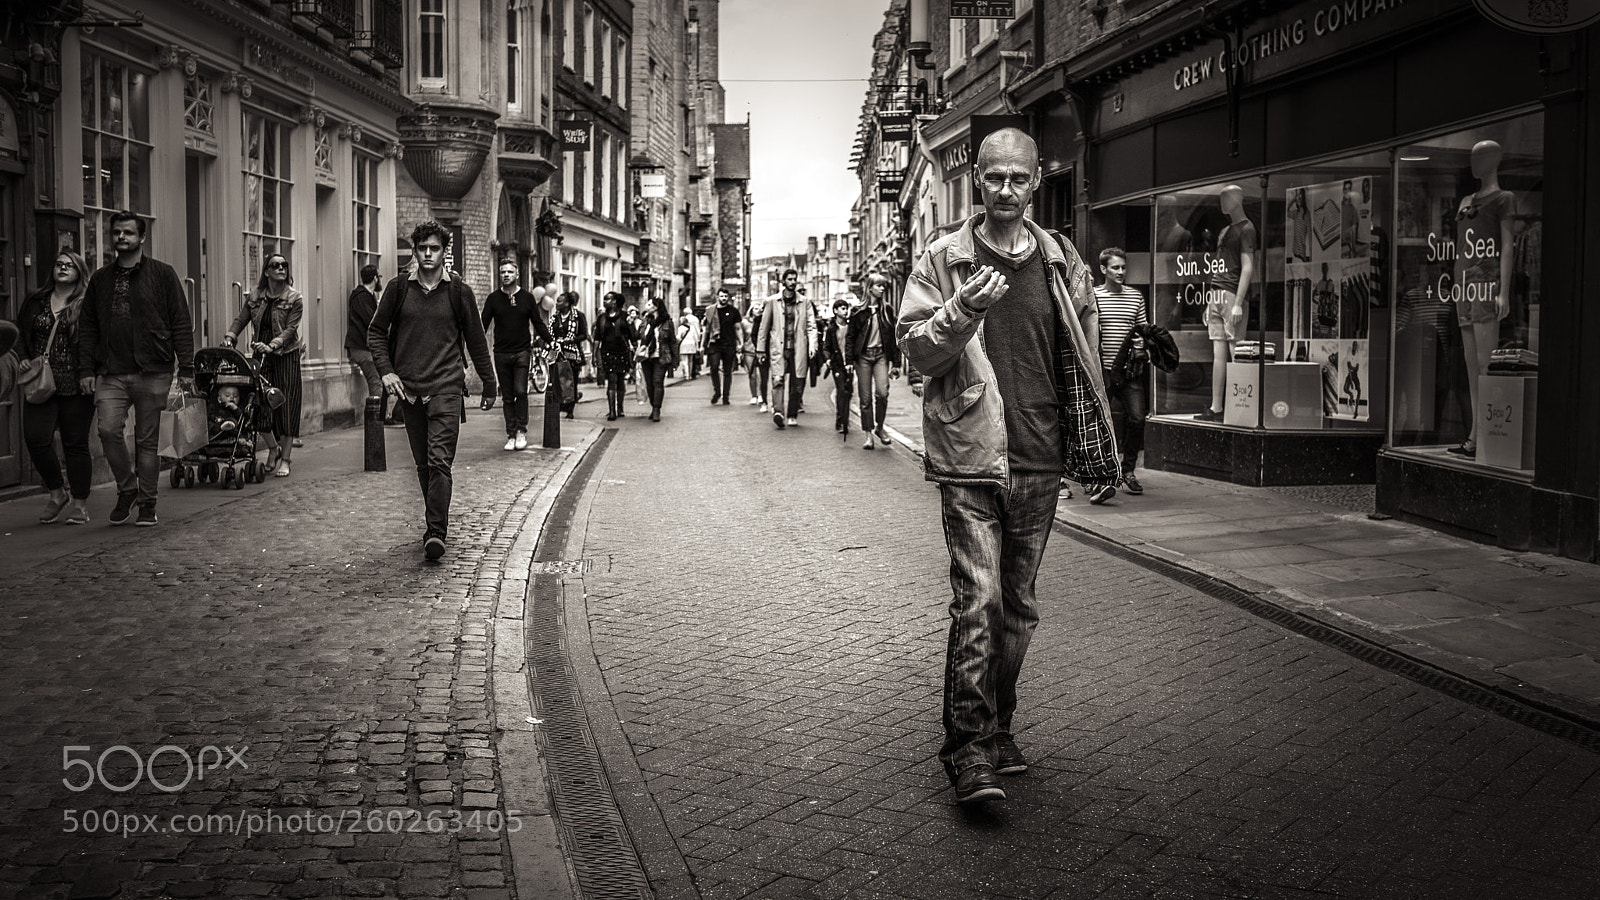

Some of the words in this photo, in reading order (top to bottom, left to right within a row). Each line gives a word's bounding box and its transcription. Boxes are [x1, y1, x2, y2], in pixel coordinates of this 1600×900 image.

[952, 6, 1013, 16] TRINITY
[1173, 56, 1212, 91] CREW
[1218, 18, 1304, 73] COTHING
[945, 143, 968, 172] JACKS
[1426, 232, 1460, 262] Sun.
[1464, 228, 1500, 259] Sea.
[1176, 254, 1201, 277] Sun.
[1203, 252, 1229, 274] Sea.
[1184, 281, 1228, 306] Colour.
[1437, 270, 1498, 303] Colour.
[1232, 383, 1238, 396] 3
[1247, 384, 1253, 398] 2
[1486, 403, 1493, 421] 3
[1504, 404, 1513, 423] 2
